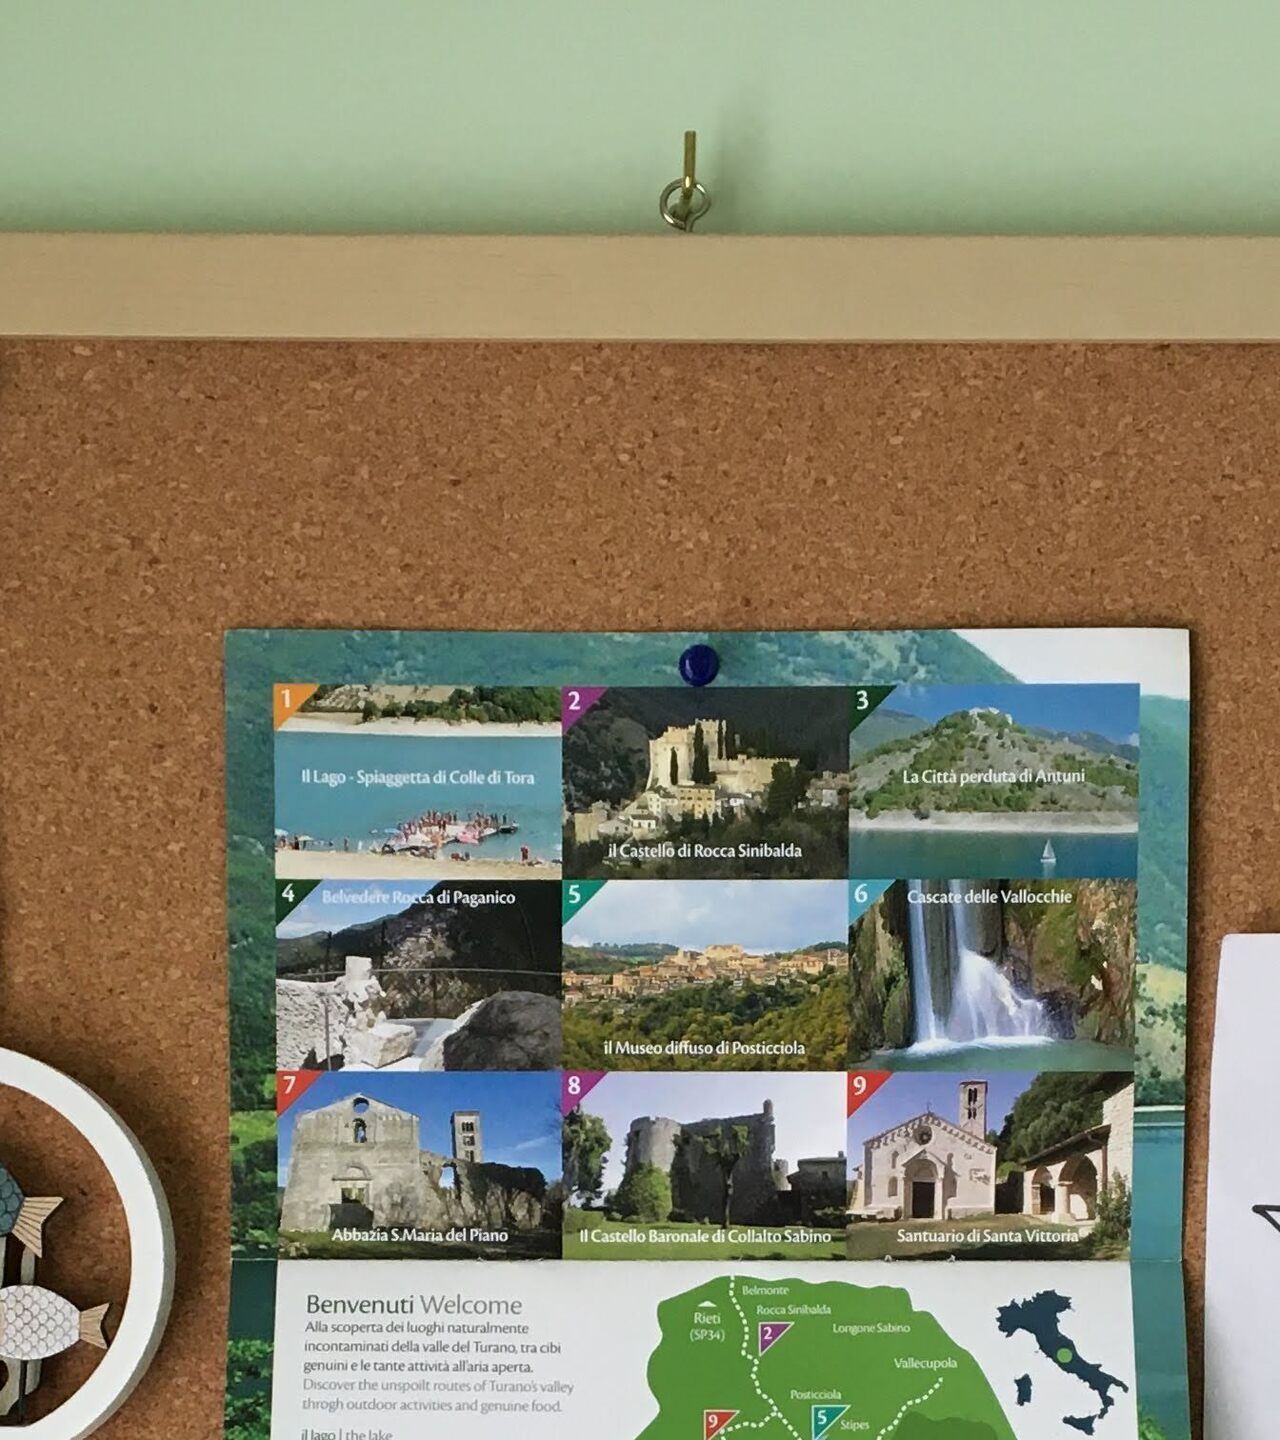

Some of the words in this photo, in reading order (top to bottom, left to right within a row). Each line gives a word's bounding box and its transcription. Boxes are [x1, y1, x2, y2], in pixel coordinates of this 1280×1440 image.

[280, 689, 291, 708] 1
[568, 691, 580, 711] 2
[857, 690, 869, 710] 3
[301, 770, 310, 784] Il
[313, 770, 346, 788] Lago
[356, 770, 430, 788] Spiaggetta
[434, 770, 446, 784] di
[450, 770, 485, 784] Colle
[488, 770, 501, 784] di
[504, 770, 535, 784] Tora
[903, 769, 919, 784] La
[922, 769, 957, 784] Città
[960, 769, 1016, 787] perduta
[1019, 769, 1032, 784] di
[1035, 769, 1085, 784] Antuni
[608, 843, 617, 858] il
[620, 843, 675, 858] Castello
[677, 843, 691, 858] di
[694, 843, 735, 858] Rocca
[738, 843, 802, 858] Sinibalda
[281, 883, 295, 902] 4
[392, 890, 434, 904] Rocca
[437, 890, 450, 904] di
[453, 890, 515, 908] Paganico
[568, 885, 580, 904] 5
[854, 883, 867, 902] 6
[907, 889, 961, 904] Cascate
[964, 889, 998, 904] delle
[1000, 889, 1072, 904] Vallocchie
[604, 1041, 612, 1055] il
[615, 1041, 662, 1055] Museo
[665, 1041, 713, 1055] diffuso
[716, 1041, 729, 1055] di
[732, 1041, 805, 1055] Posticciola
[284, 1075, 296, 1094] 7
[568, 1076, 580, 1095] 8
[854, 1076, 866, 1095] 9
[332, 1228, 388, 1243] Abbazia
[391, 1228, 443, 1243] S.Maria
[445, 1228, 467, 1243] del
[469, 1228, 508, 1243] Piano
[580, 1229, 589, 1243] Il
[591, 1229, 646, 1243] Castello
[649, 1229, 709, 1243] Baronale
[711, 1229, 725, 1243] di
[728, 1229, 781, 1243] Collalto
[784, 1229, 831, 1243] Sabino
[897, 1229, 964, 1243] Santuario
[967, 1229, 980, 1243] di
[983, 1229, 1022, 1243] Santa
[1024, 1229, 1079, 1243] Vittoria
[742, 1285, 789, 1295] Belmonte
[307, 1295, 413, 1314] Benvenuti
[420, 1294, 522, 1314] Welcome
[757, 1305, 786, 1315] Rocca
[788, 1304, 831, 1314] Sinibalda
[694, 1312, 720, 1324] Rieti
[305, 1320, 328, 1333] Alla
[331, 1324, 383, 1336] scoperta
[386, 1321, 404, 1333] dei
[407, 1321, 444, 1336] luoghi
[447, 1322, 529, 1334] naturalmente
[690, 1329, 725, 1342] (SP34)
[894, 1357, 957, 1371] Vallecupola
[791, 1389, 841, 1399] Posticciola
[840, 1417, 869, 1431] Stipes
